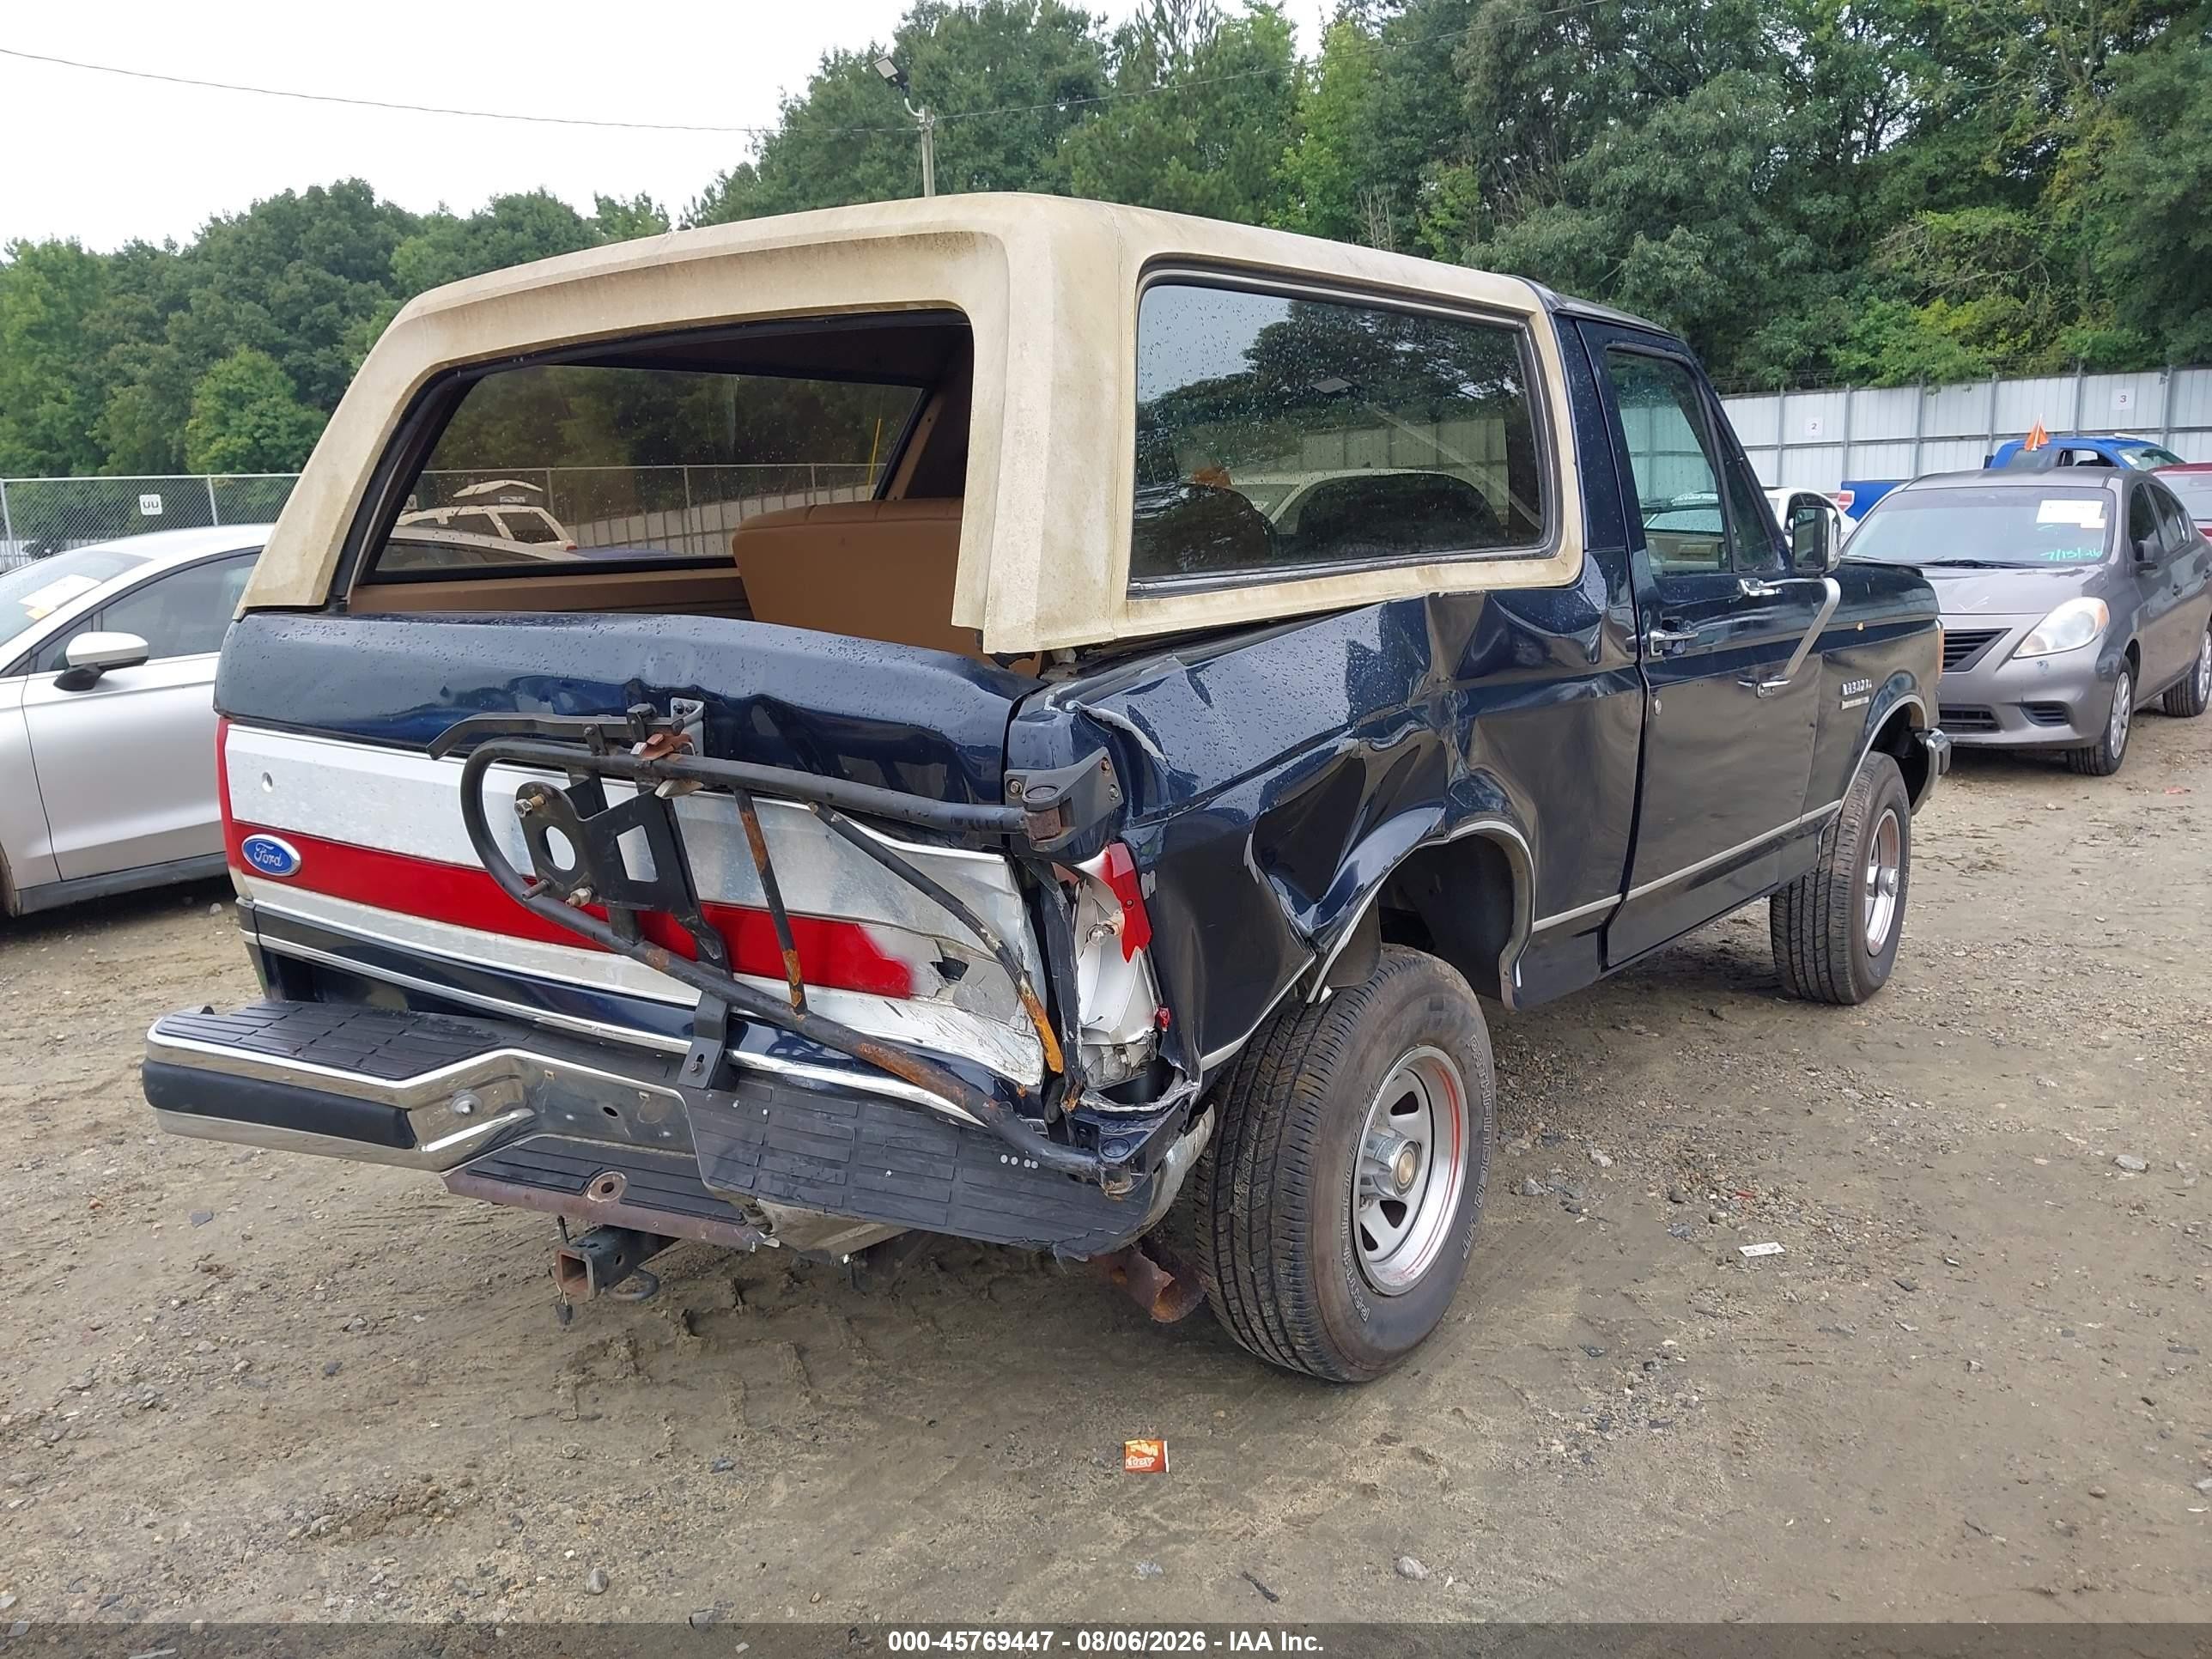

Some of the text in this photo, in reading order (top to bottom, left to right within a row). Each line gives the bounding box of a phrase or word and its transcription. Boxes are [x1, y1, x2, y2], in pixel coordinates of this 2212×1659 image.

[2119, 394, 2127, 403] 3
[1811, 422, 1818, 430] 2
[253, 842, 283, 867] Ford
